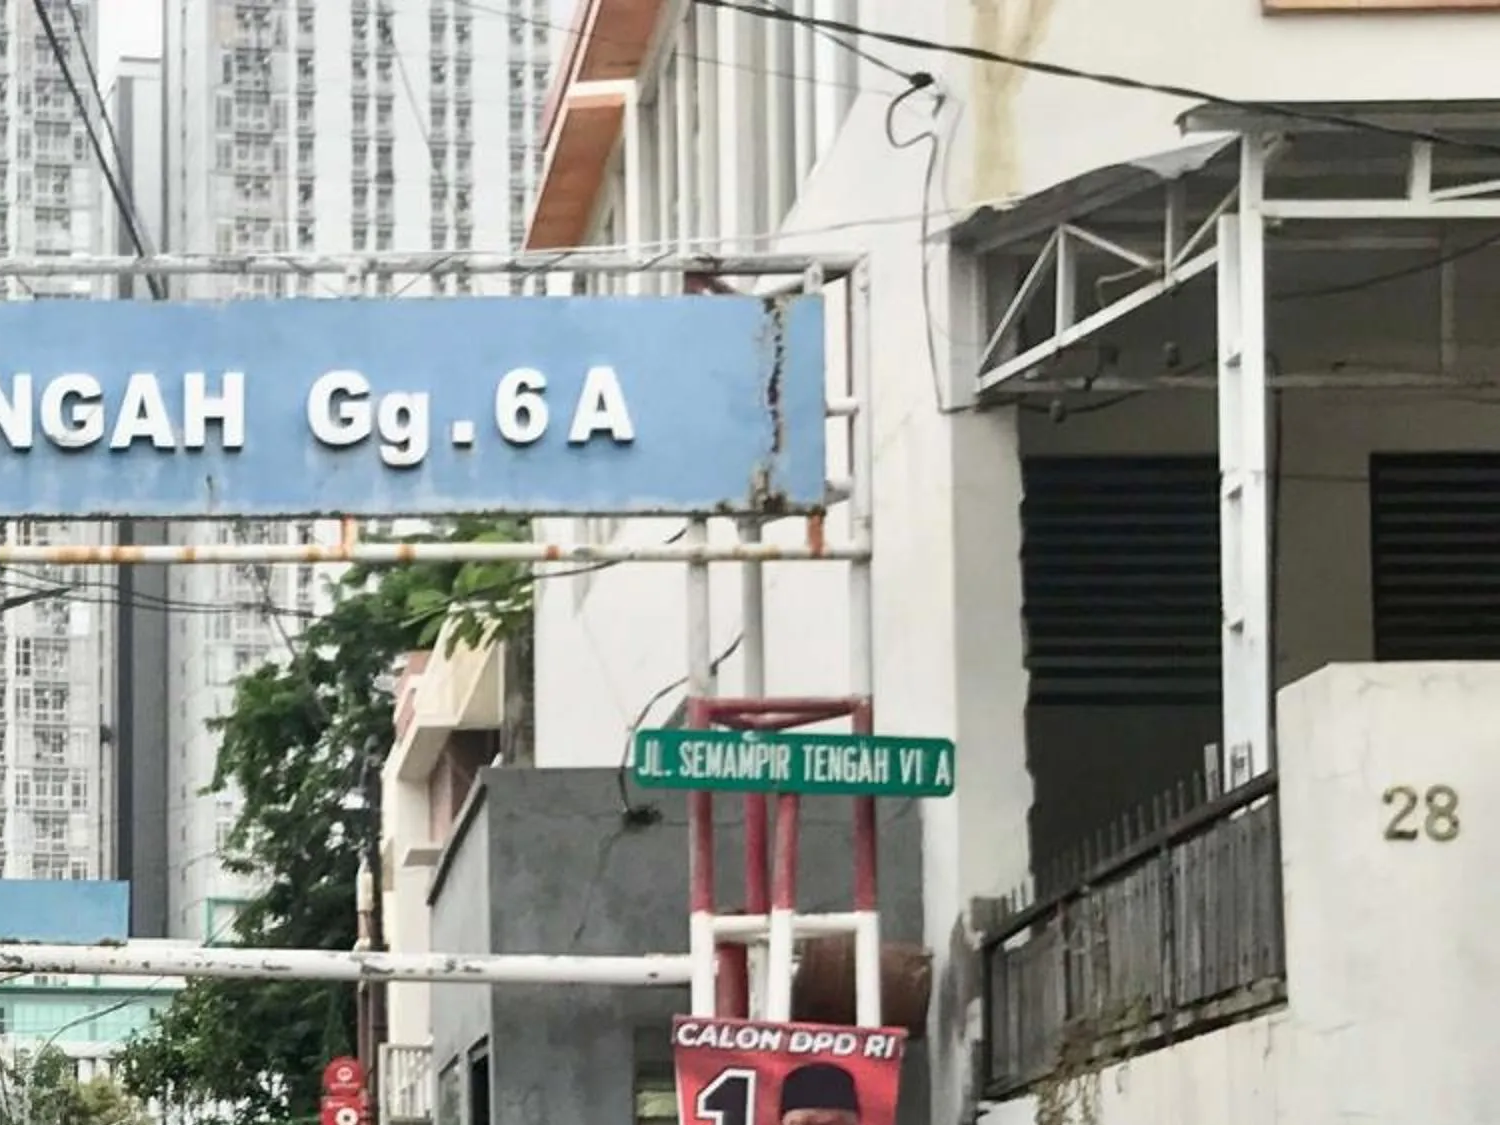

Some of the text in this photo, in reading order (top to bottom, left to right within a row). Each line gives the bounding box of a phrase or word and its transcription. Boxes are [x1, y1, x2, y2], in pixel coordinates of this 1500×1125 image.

[493, 366, 550, 446] 6
[567, 364, 636, 443] A
[638, 740, 951, 787] JL. SEMAMPIR TENGAH VI A
[1382, 784, 1460, 842] 28
[675, 1024, 896, 1059] CALON DPD RI
